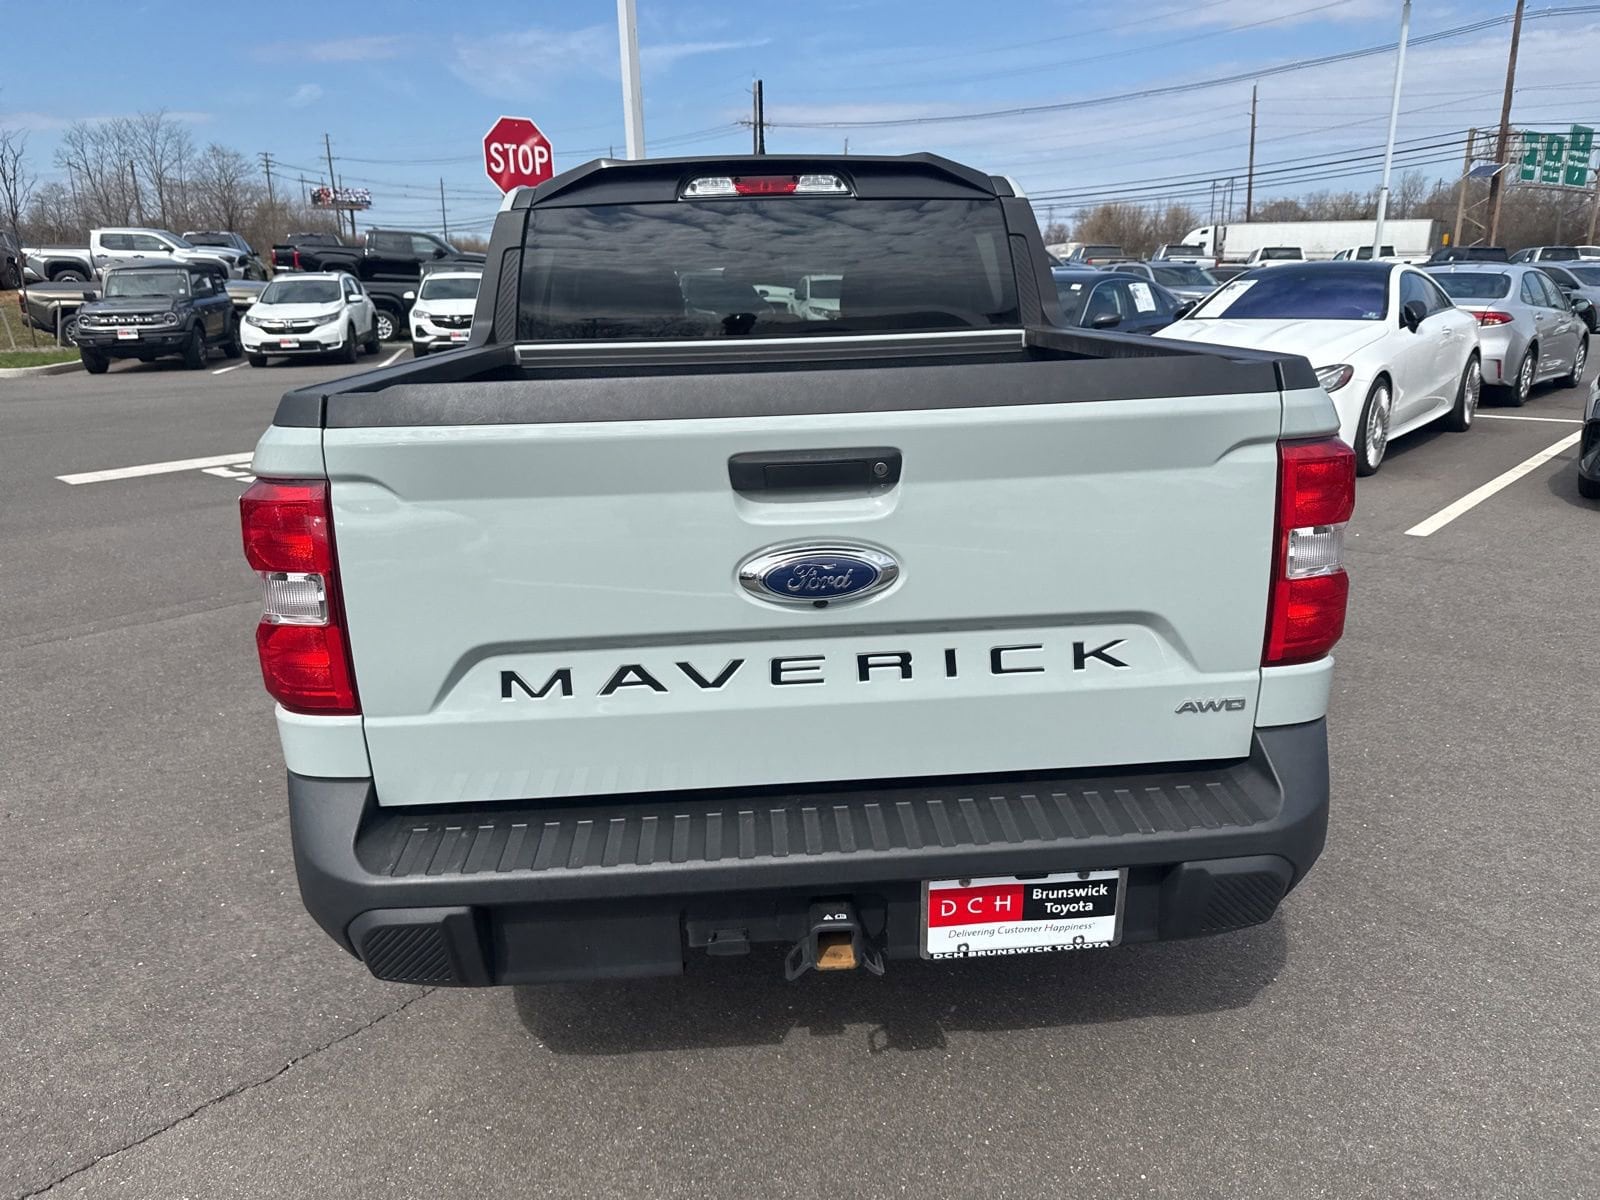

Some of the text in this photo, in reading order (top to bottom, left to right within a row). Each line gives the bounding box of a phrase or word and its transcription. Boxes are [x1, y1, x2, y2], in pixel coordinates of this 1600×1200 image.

[490, 142, 548, 175] STOP
[787, 563, 852, 592] Ford
[500, 638, 1131, 699] MAVERICK
[1174, 698, 1245, 714] AWD
[1032, 884, 1108, 900] Brunswick
[1044, 900, 1094, 916] Toyota
[948, 921, 1094, 939] Delivering Customer Happiness
[933, 940, 1109, 960] DCH BRUNSWICK TOYOTA
